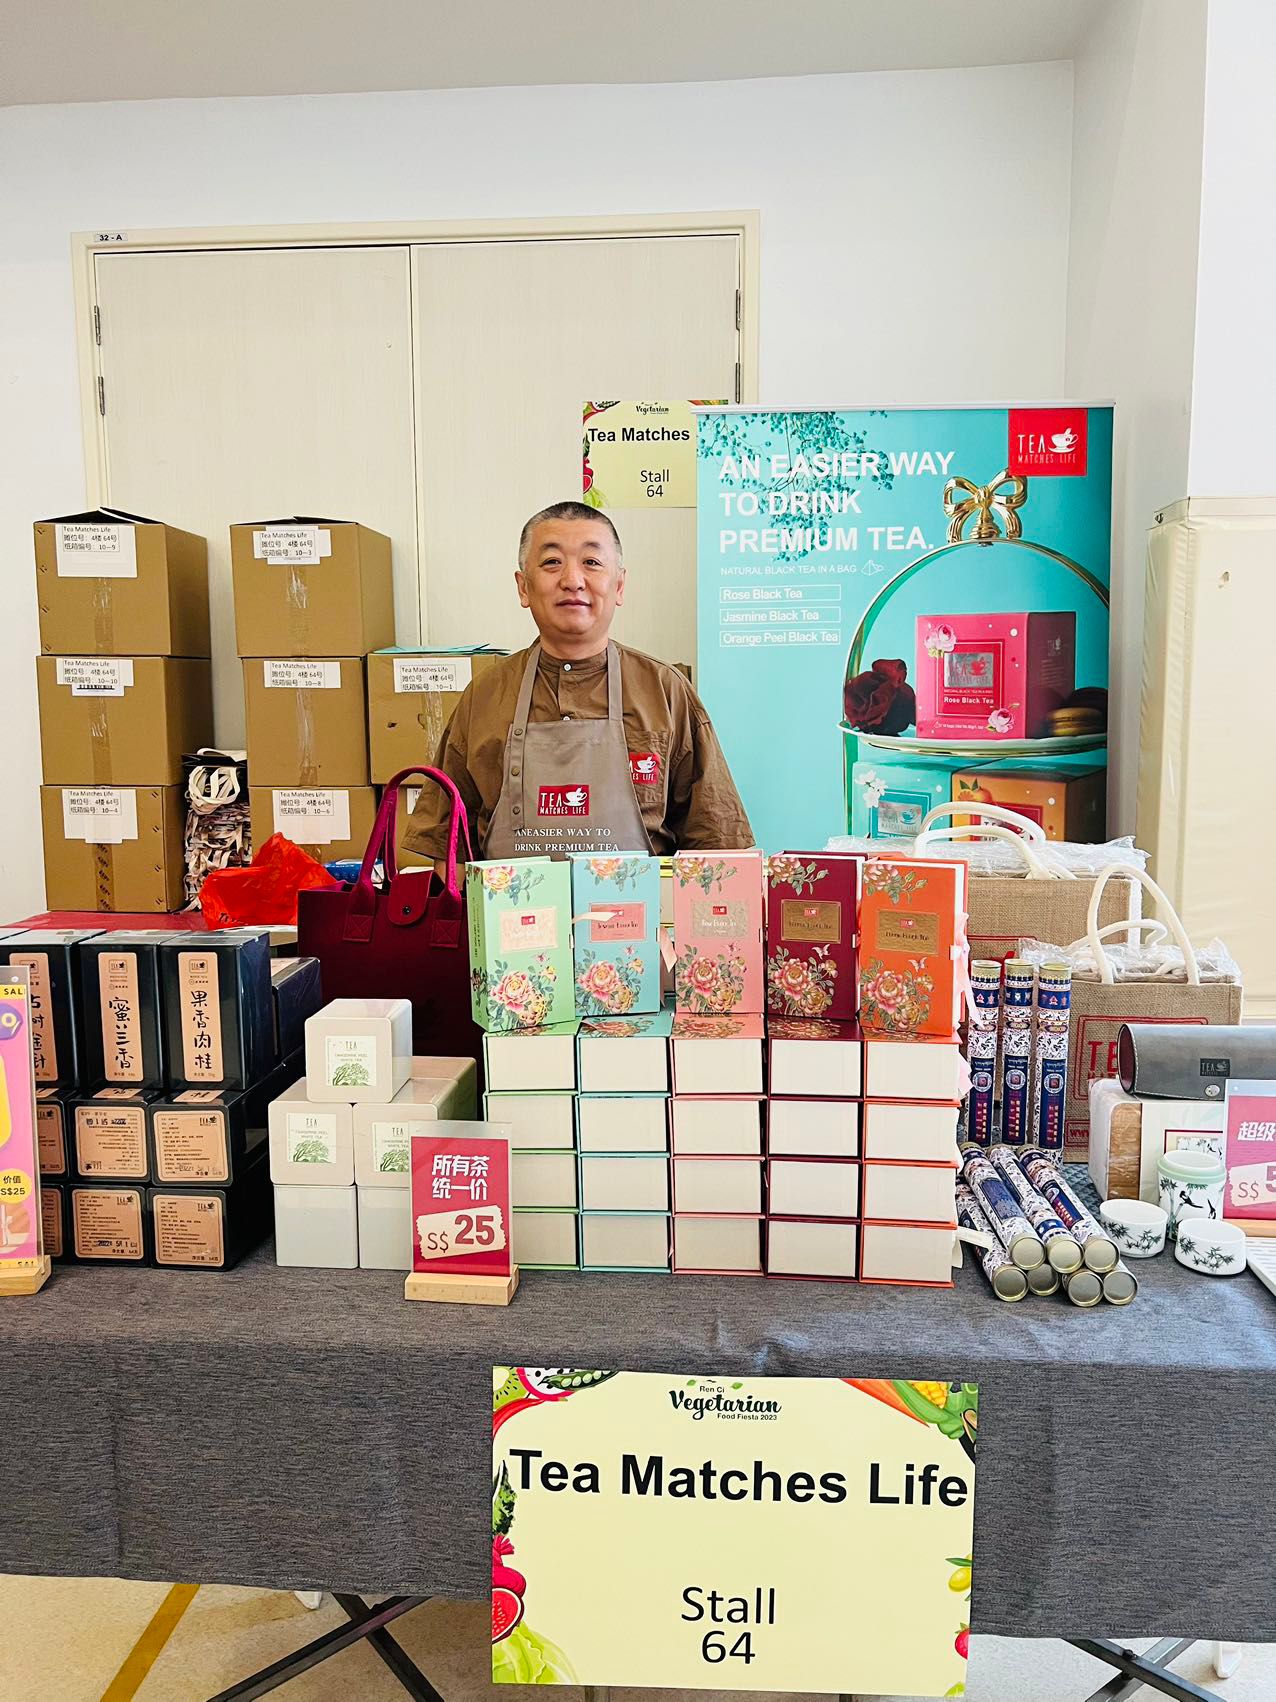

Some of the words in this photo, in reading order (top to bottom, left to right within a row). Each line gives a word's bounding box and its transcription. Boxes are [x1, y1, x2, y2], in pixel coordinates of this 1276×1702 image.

[636, 405, 669, 415] Vegetarian
[588, 428, 616, 441] Tea
[621, 427, 690, 441] Matches
[1017, 433, 1046, 453] TEA
[718, 455, 760, 479] AN
[770, 452, 880, 478] EASIER
[889, 451, 955, 476] WAY
[1017, 454, 1054, 464] MATCHES
[1060, 454, 1076, 464] LIFE
[640, 469, 669, 482] Stall
[646, 484, 664, 497] 64
[719, 492, 759, 517] TO
[768, 490, 862, 515] DRINK
[720, 527, 858, 554] PREMIUM
[867, 526, 934, 550] TEA.
[720, 567, 762, 575] NATURAL
[765, 566, 796, 574] BLACK
[799, 565, 816, 573] TEA
[818, 565, 827, 573] IN
[829, 565, 835, 573] A
[838, 565, 857, 573] BAG
[723, 589, 750, 599] Rose
[752, 588, 782, 599] Black
[784, 588, 802, 598] Tea
[723, 611, 767, 622] Jasmine
[769, 610, 798, 621] Black
[801, 610, 820, 620] Tea
[723, 632, 762, 646] Orange
[764, 632, 787, 643] Peel
[788, 631, 818, 642] Black
[820, 631, 838, 641] Tea
[541, 793, 562, 807] TEA
[566, 828, 593, 836] WAY
[596, 828, 611, 836] TO
[191, 990, 212, 1069] 果香肉桂
[346, 1041, 357, 1049] TEA
[1202, 1062, 1214, 1072] TEA
[306, 1118, 317, 1126] TEA
[392, 1127, 404, 1136] TEA
[1237, 1121, 1276, 1141] 超级
[432, 1155, 490, 1177] 所有茶
[3, 1175, 21, 1184] 价值
[0, 1187, 26, 1196] S$25
[432, 1178, 488, 1200] 统一价
[1238, 1181, 1260, 1201] S$
[427, 1231, 449, 1253] S$
[454, 1214, 495, 1246] 25
[669, 1390, 782, 1420] Vegetarian
[509, 1448, 600, 1494] Tea
[621, 1453, 847, 1504] Matches
[869, 1462, 968, 1507] Life
[681, 1586, 776, 1625] Stall
[701, 1631, 756, 1665] 64
